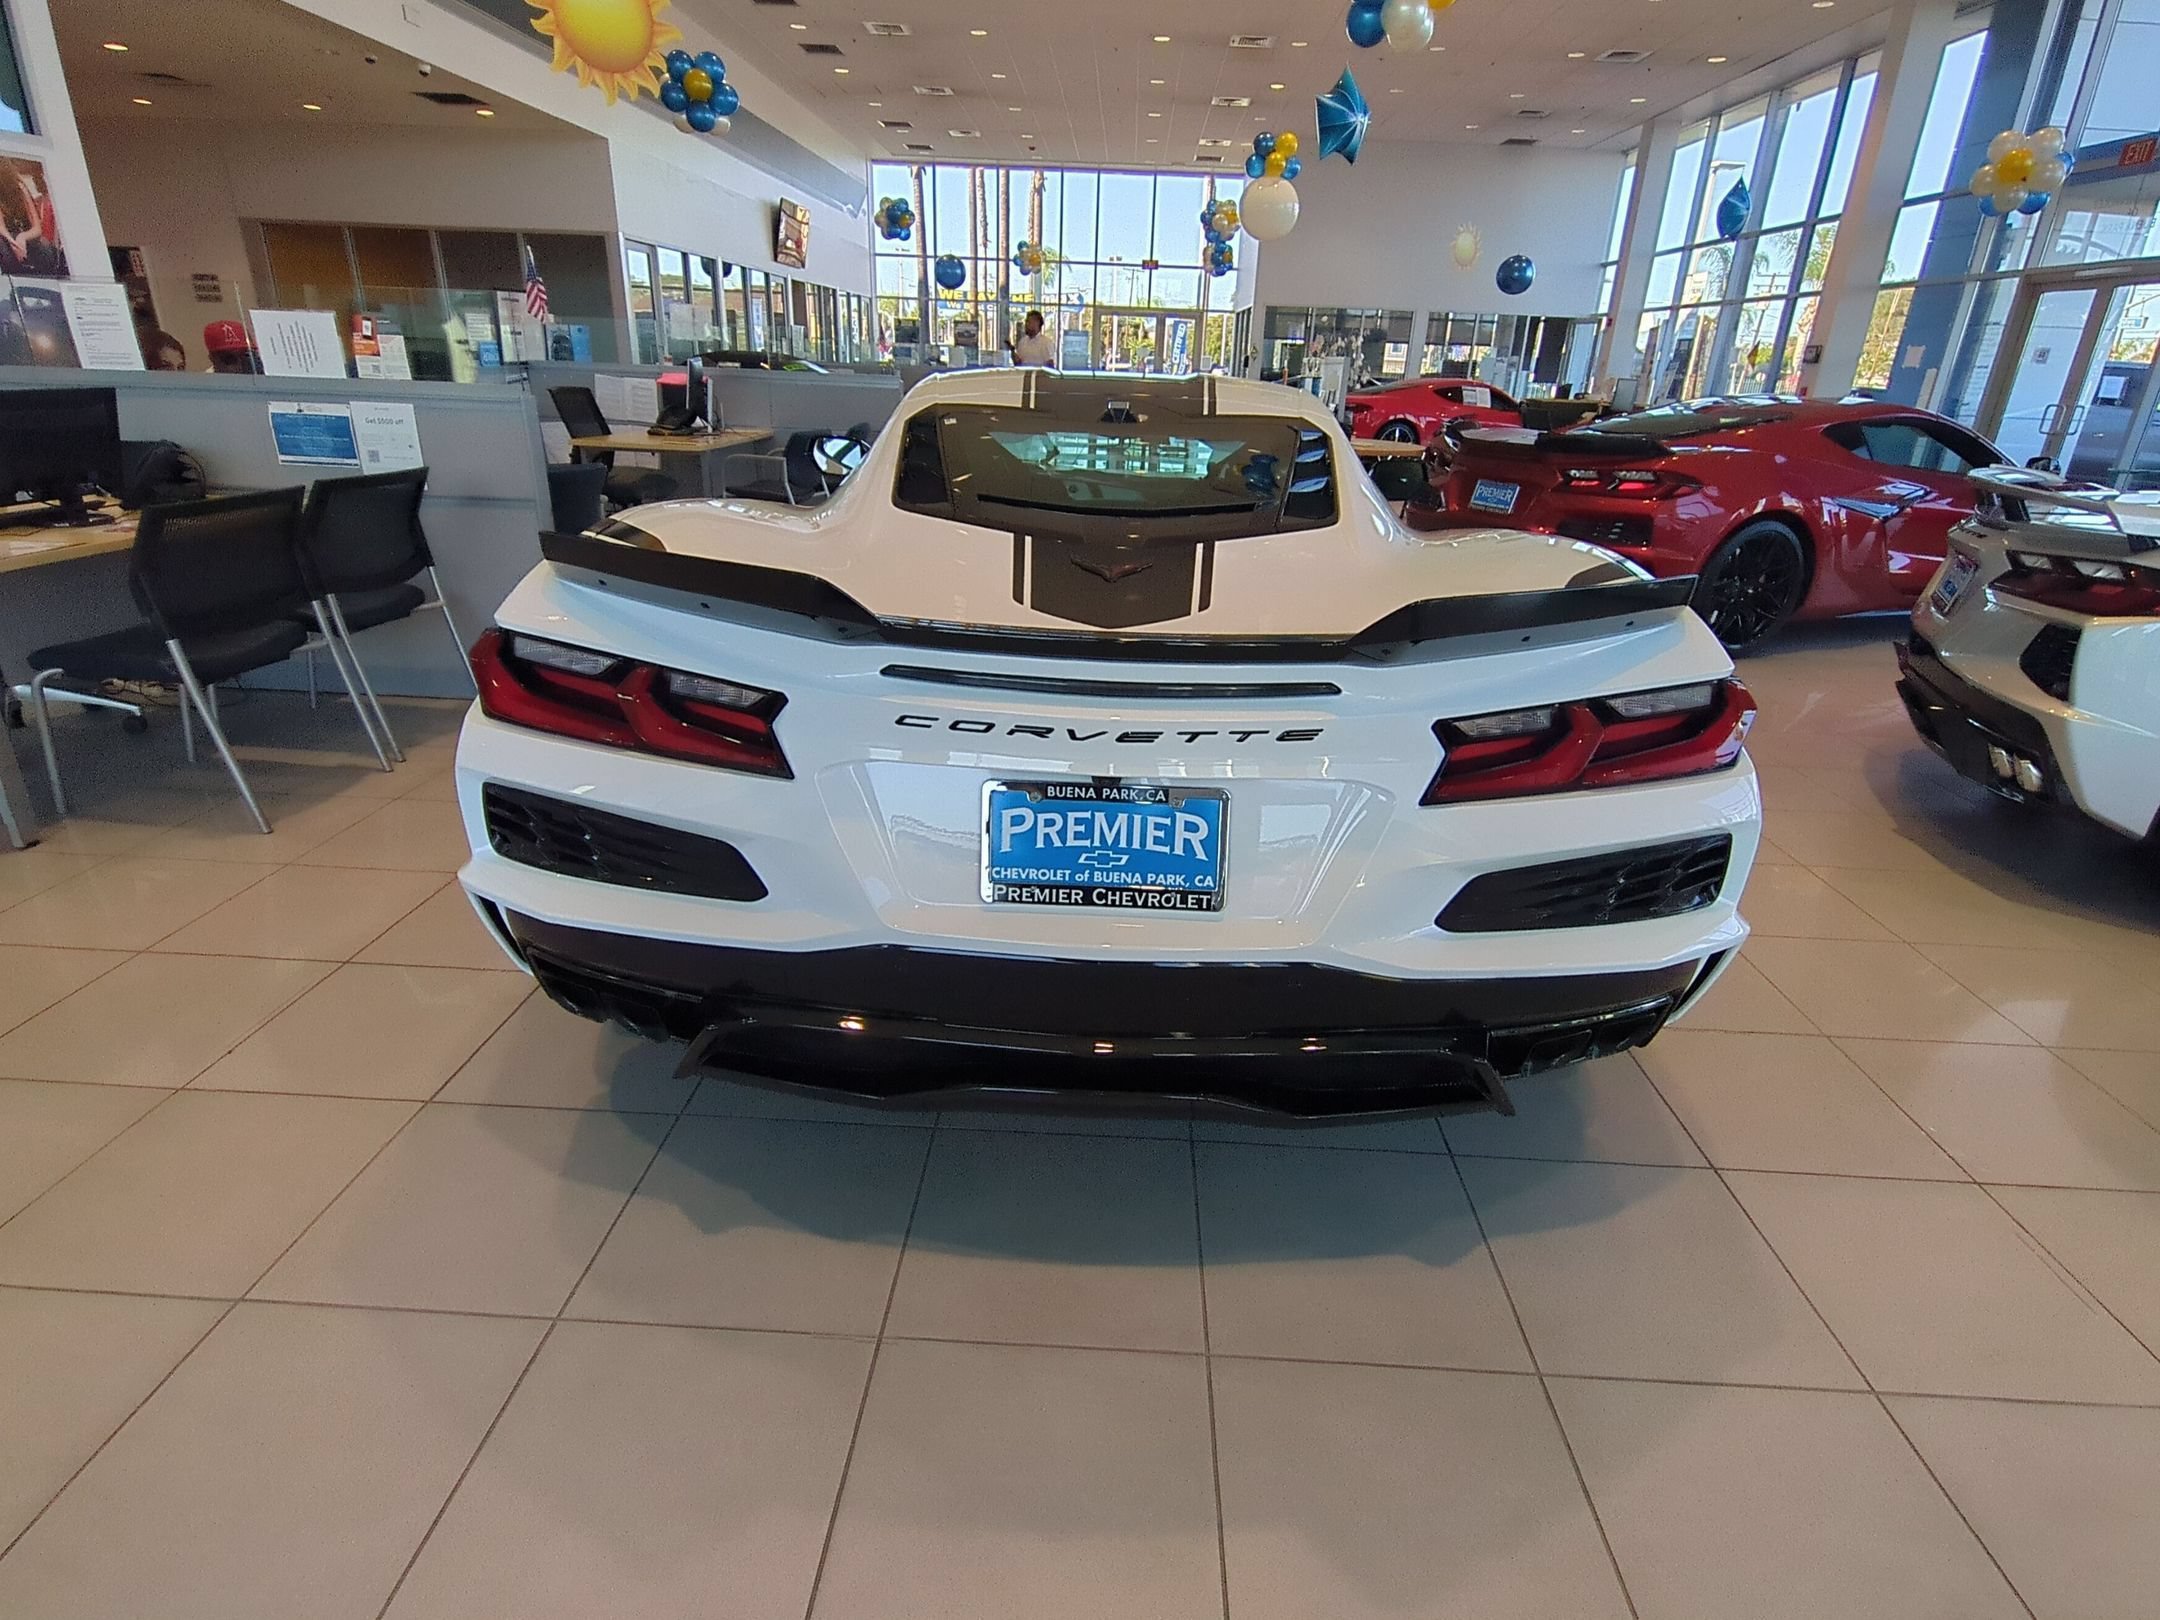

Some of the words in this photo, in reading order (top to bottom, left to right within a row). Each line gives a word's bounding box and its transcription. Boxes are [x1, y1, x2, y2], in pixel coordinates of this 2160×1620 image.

[2125, 140, 2153, 164] EXIT
[1476, 486, 1514, 503] PREMIER
[894, 714, 1324, 744] CORVETTE
[1047, 786, 1097, 799] BUENA
[999, 807, 1209, 861] PREMIER
[992, 867, 1071, 881] CHEVROLET
[1075, 870, 1090, 882] of
[1094, 871, 1142, 884] BUENA
[1147, 873, 1190, 887] PARK,
[1194, 875, 1214, 887] CA
[993, 884, 1084, 903] PREMIER
[1092, 888, 1211, 909] CHEVROLET
